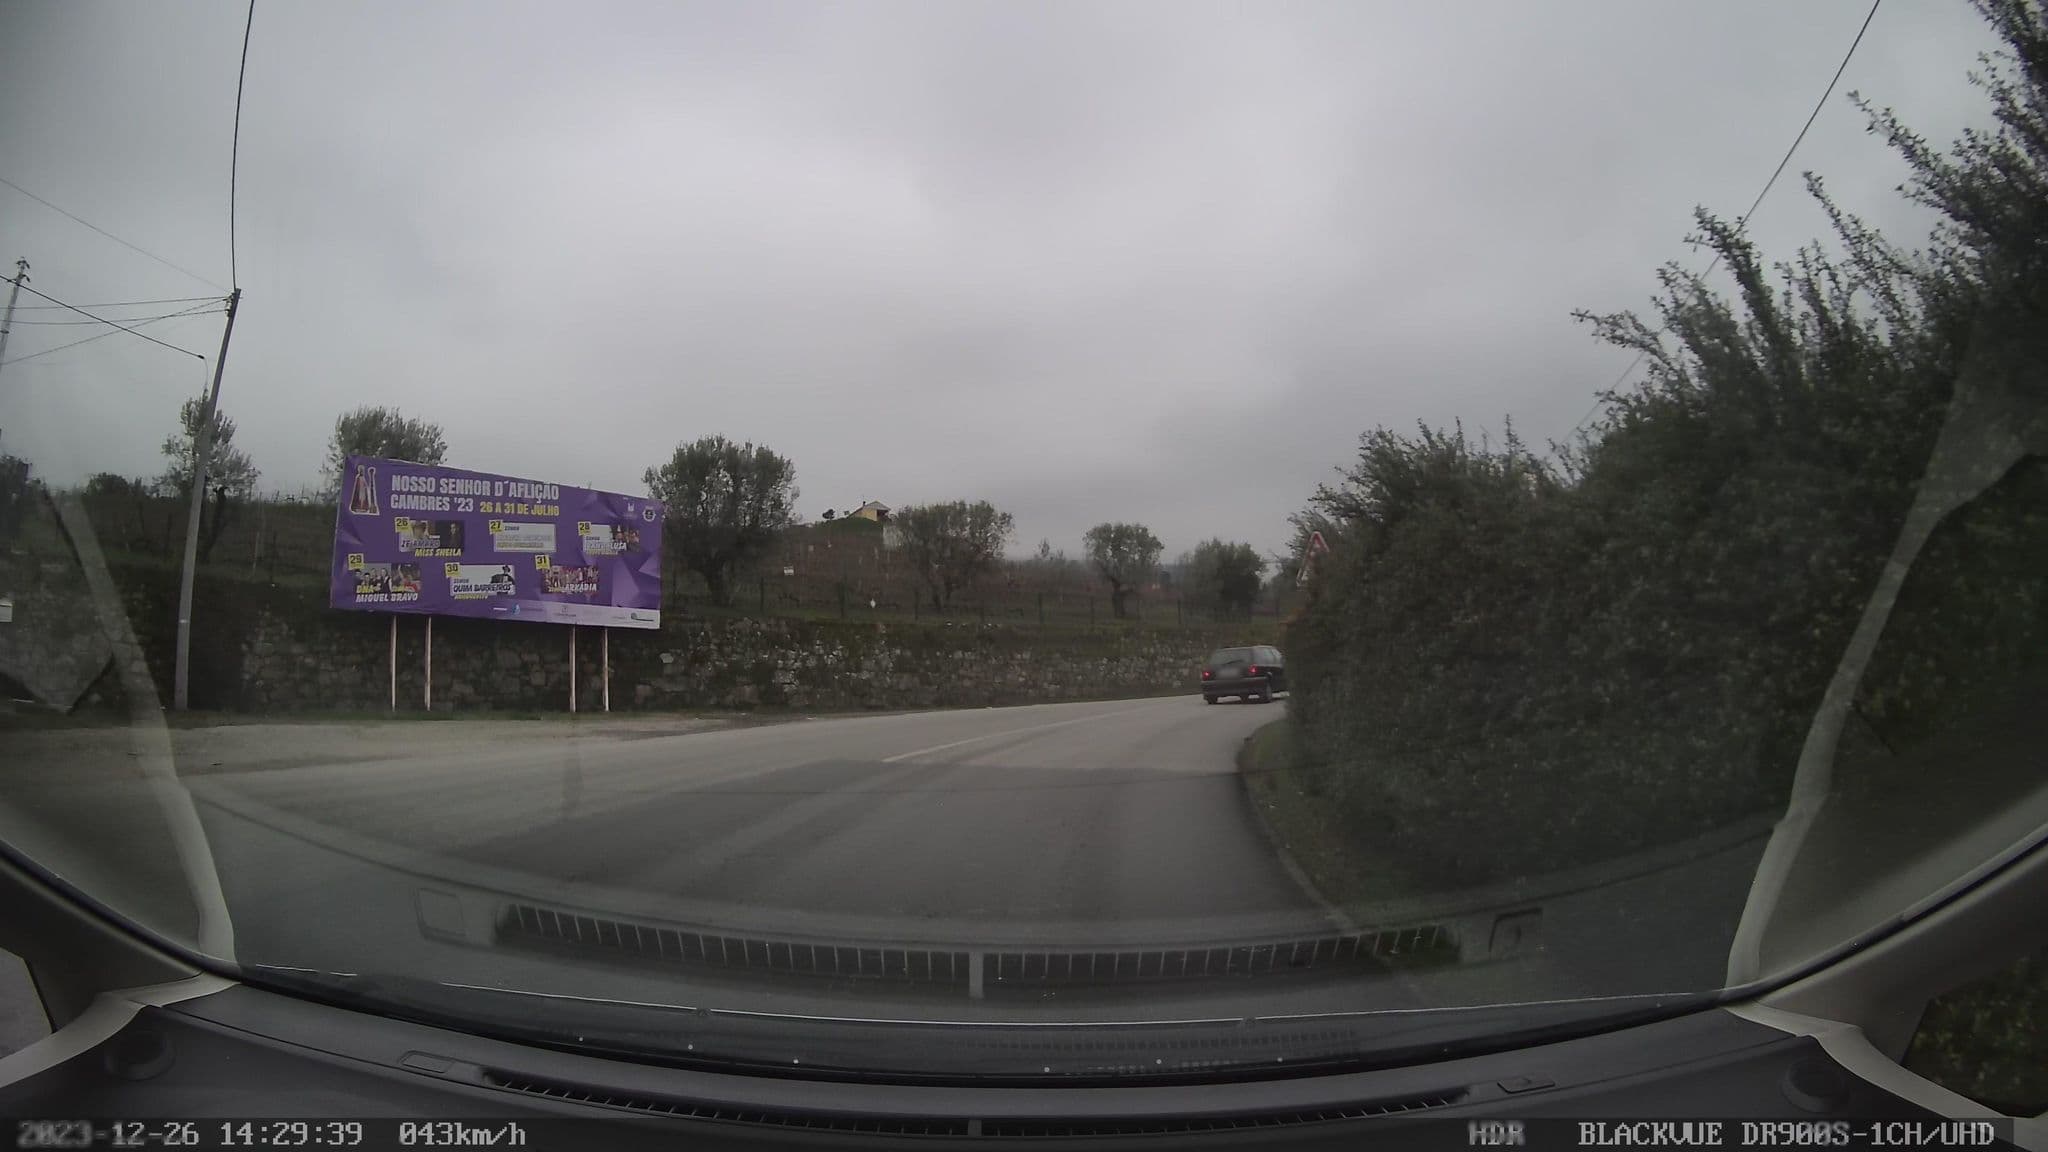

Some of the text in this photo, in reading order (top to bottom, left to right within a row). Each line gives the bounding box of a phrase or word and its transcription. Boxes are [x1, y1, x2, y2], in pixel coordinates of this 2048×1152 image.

[391, 475, 436, 492] NOSSO
[440, 478, 491, 496] SENHOR
[390, 494, 450, 511] CAMBRES
[480, 502, 560, 516] 26 A 31 DE JULHO
[396, 518, 408, 527] 26
[490, 521, 501, 529] 27
[414, 547, 462, 557] MISS SHEILA
[537, 555, 546, 564] 31
[446, 563, 458, 573] 30
[453, 583, 512, 592] QUIM BARREIROS
[355, 592, 419, 603] MIGUEL BRAVO
